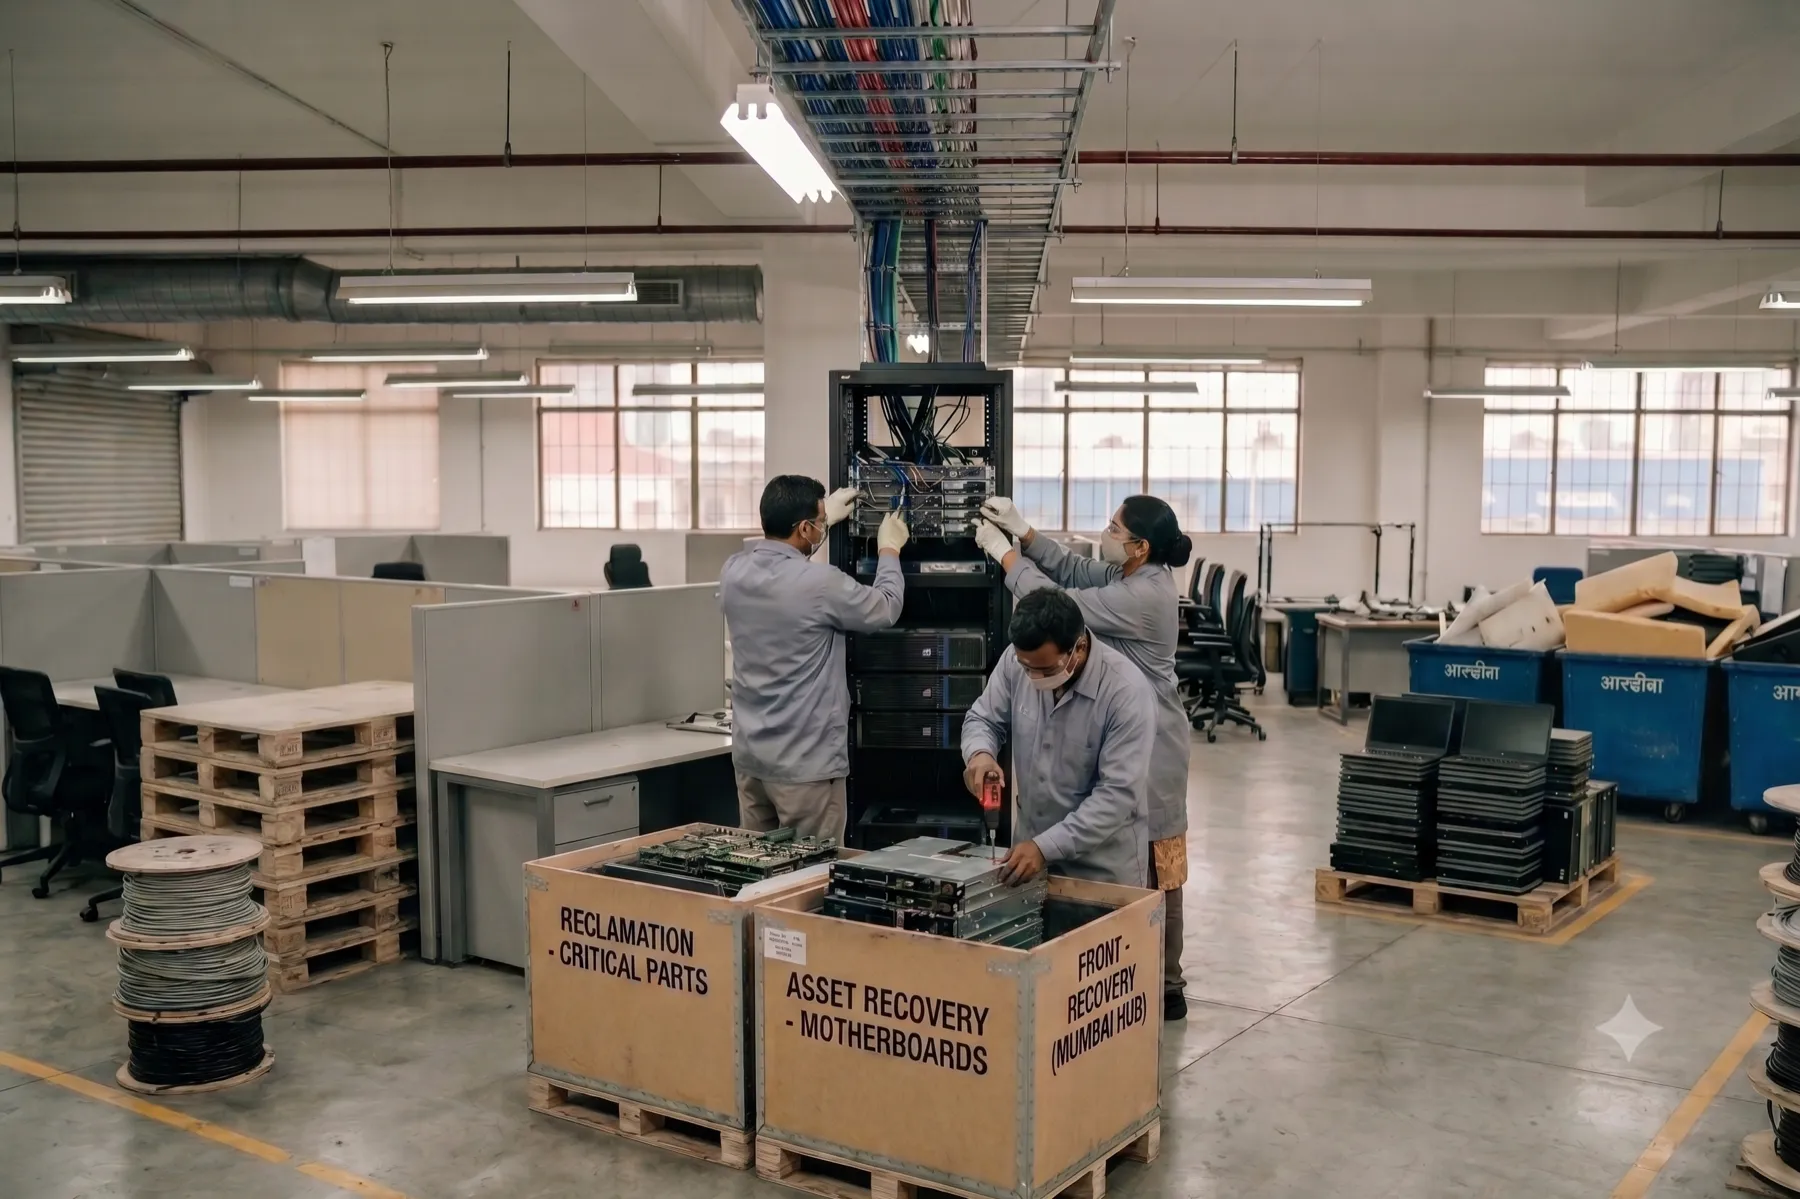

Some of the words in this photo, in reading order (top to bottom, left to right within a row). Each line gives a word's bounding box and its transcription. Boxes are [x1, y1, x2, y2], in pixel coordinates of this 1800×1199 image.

[560, 906, 694, 958] RECLAMATION
[1078, 935, 1123, 983] FRONT
[559, 940, 642, 983] CRITICAL
[646, 957, 709, 996] PARTS
[1067, 962, 1137, 1025] RECOVERY
[786, 971, 857, 1010] ASSET
[864, 984, 990, 1037] RECOVERY
[1051, 1009, 1114, 1077] (MUMBAI
[1116, 991, 1147, 1035] HUB)
[800, 1009, 988, 1076] MOTHERBOARDS
